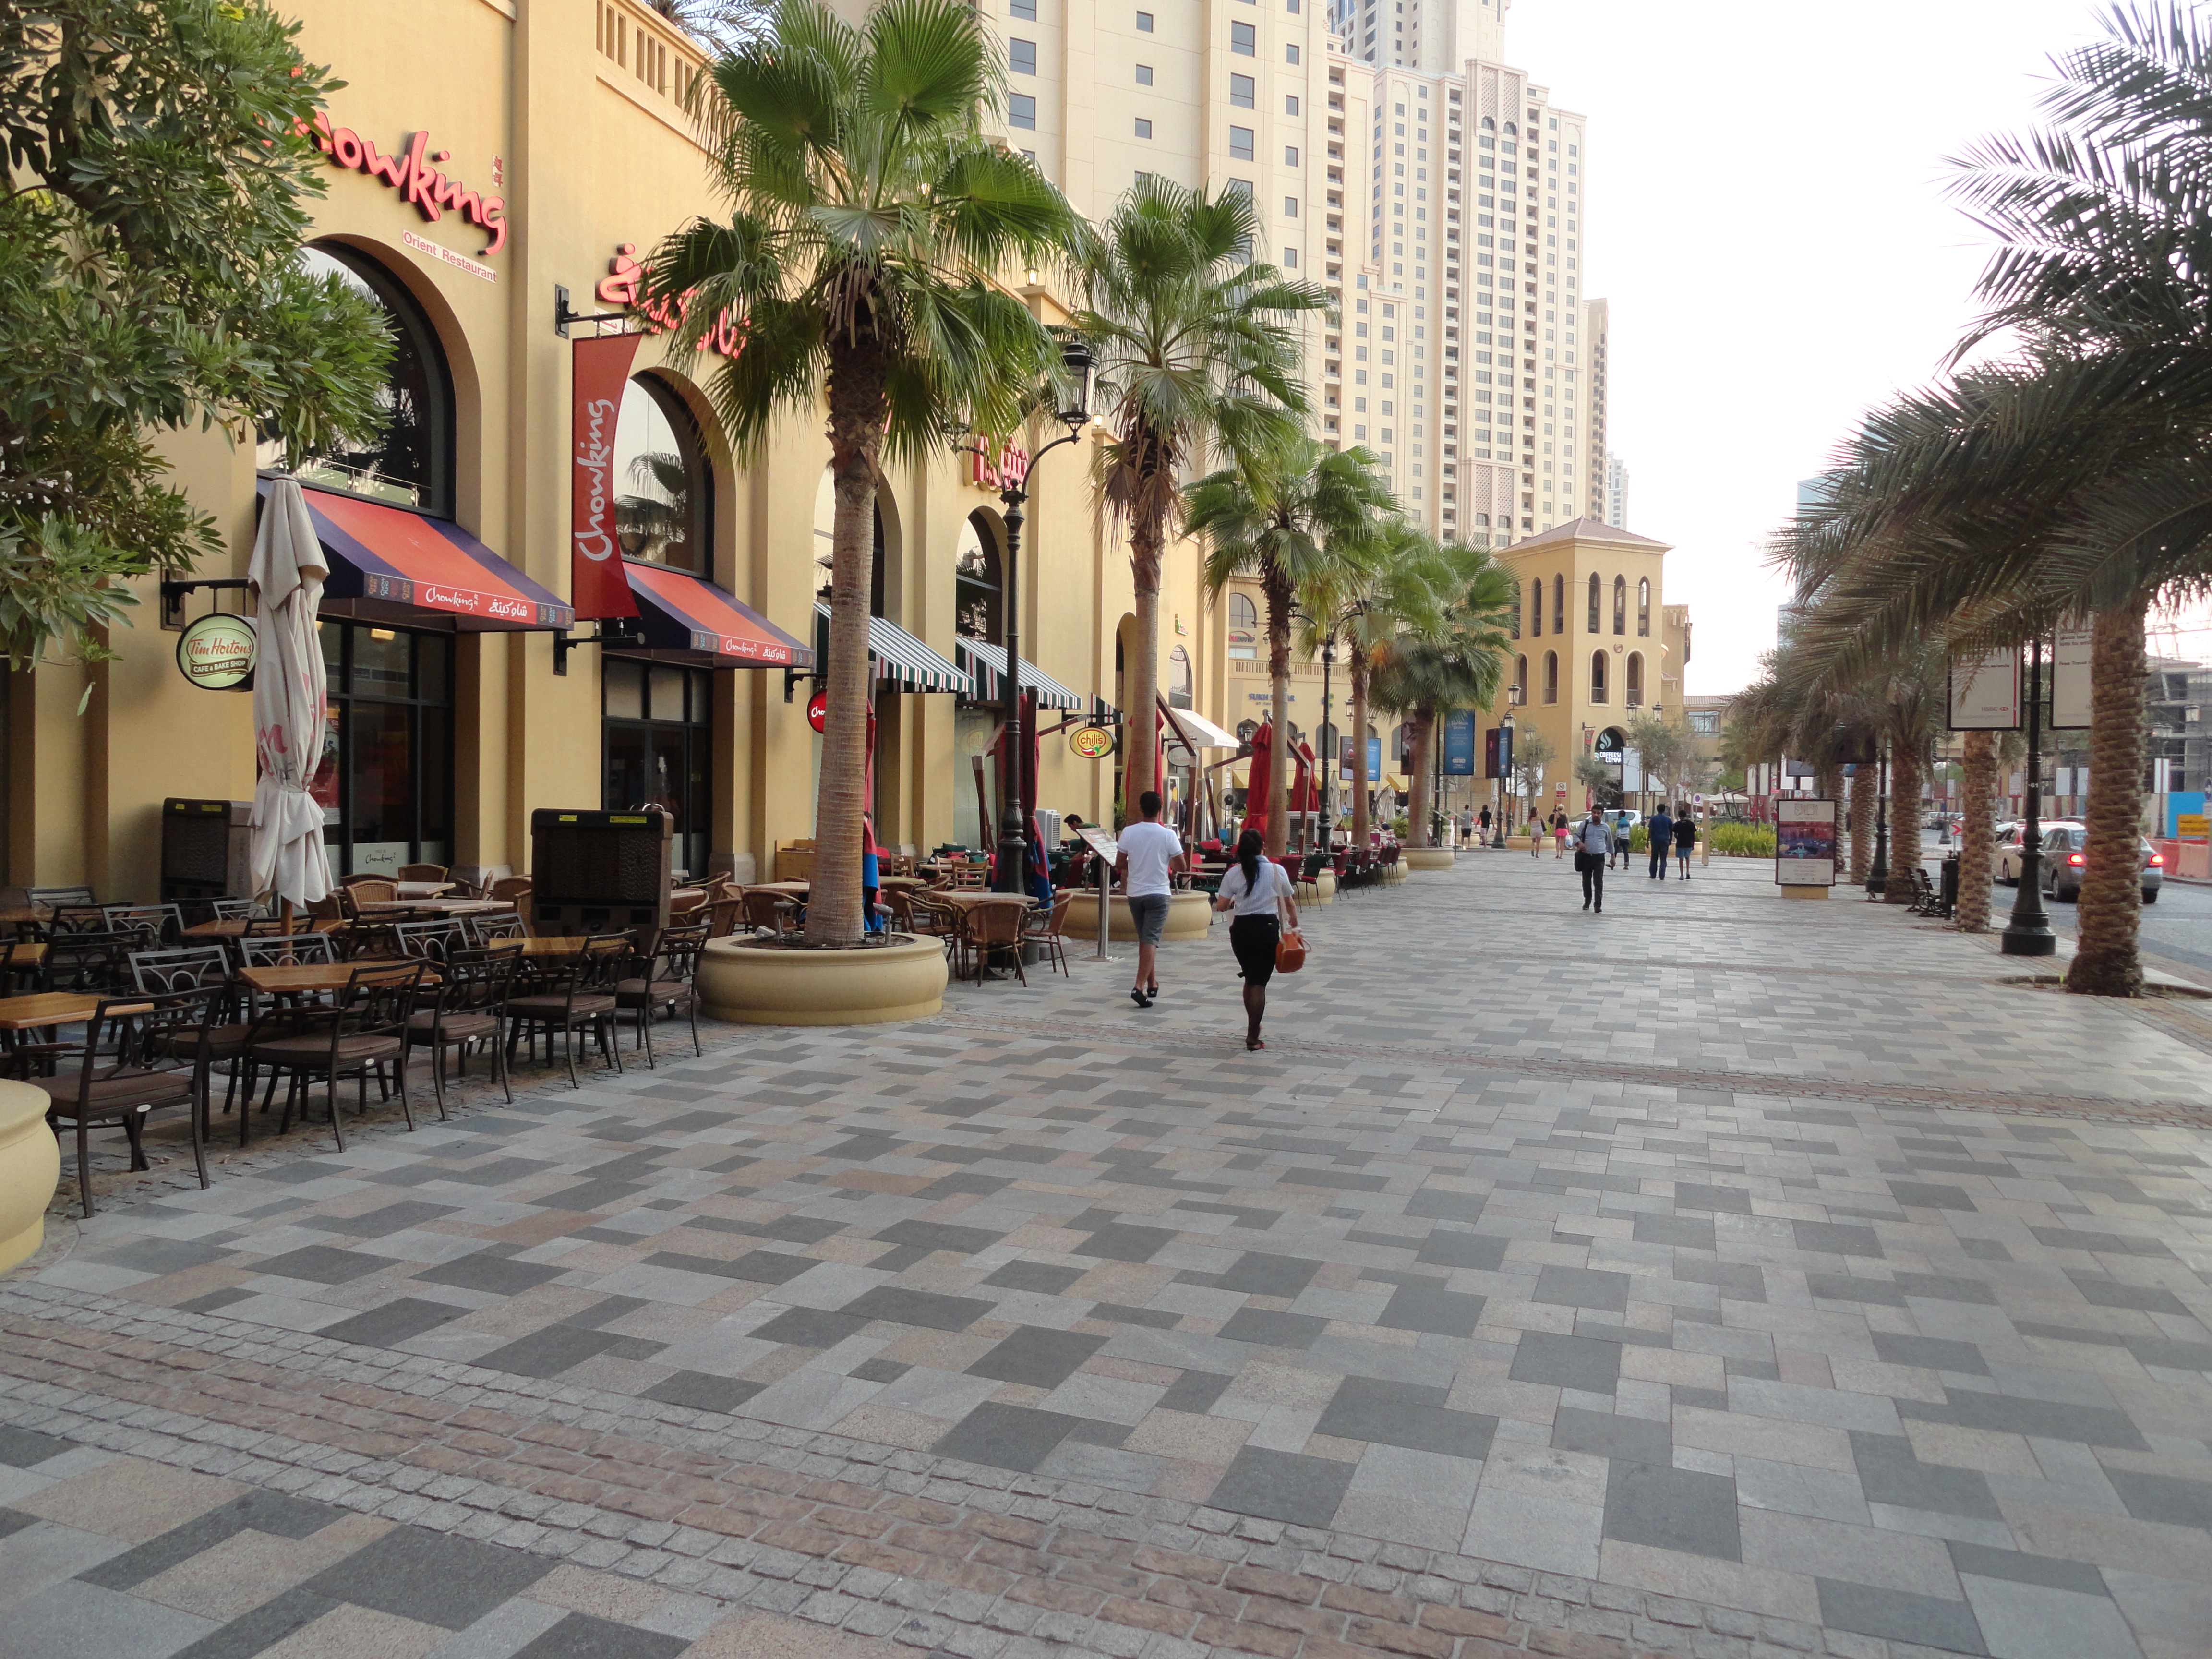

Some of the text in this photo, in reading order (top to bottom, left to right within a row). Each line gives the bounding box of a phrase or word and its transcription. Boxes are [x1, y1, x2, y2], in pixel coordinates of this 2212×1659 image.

[283, 111, 507, 255] owking
[404, 232, 497, 283] Orient Restaurant
[575, 399, 615, 561] Chowking
[426, 587, 473, 611] Chowking
[189, 637, 252, 655] Tim Hortons
[726, 639, 754, 656] Chowking
[1080, 733, 1103, 746] chili's
